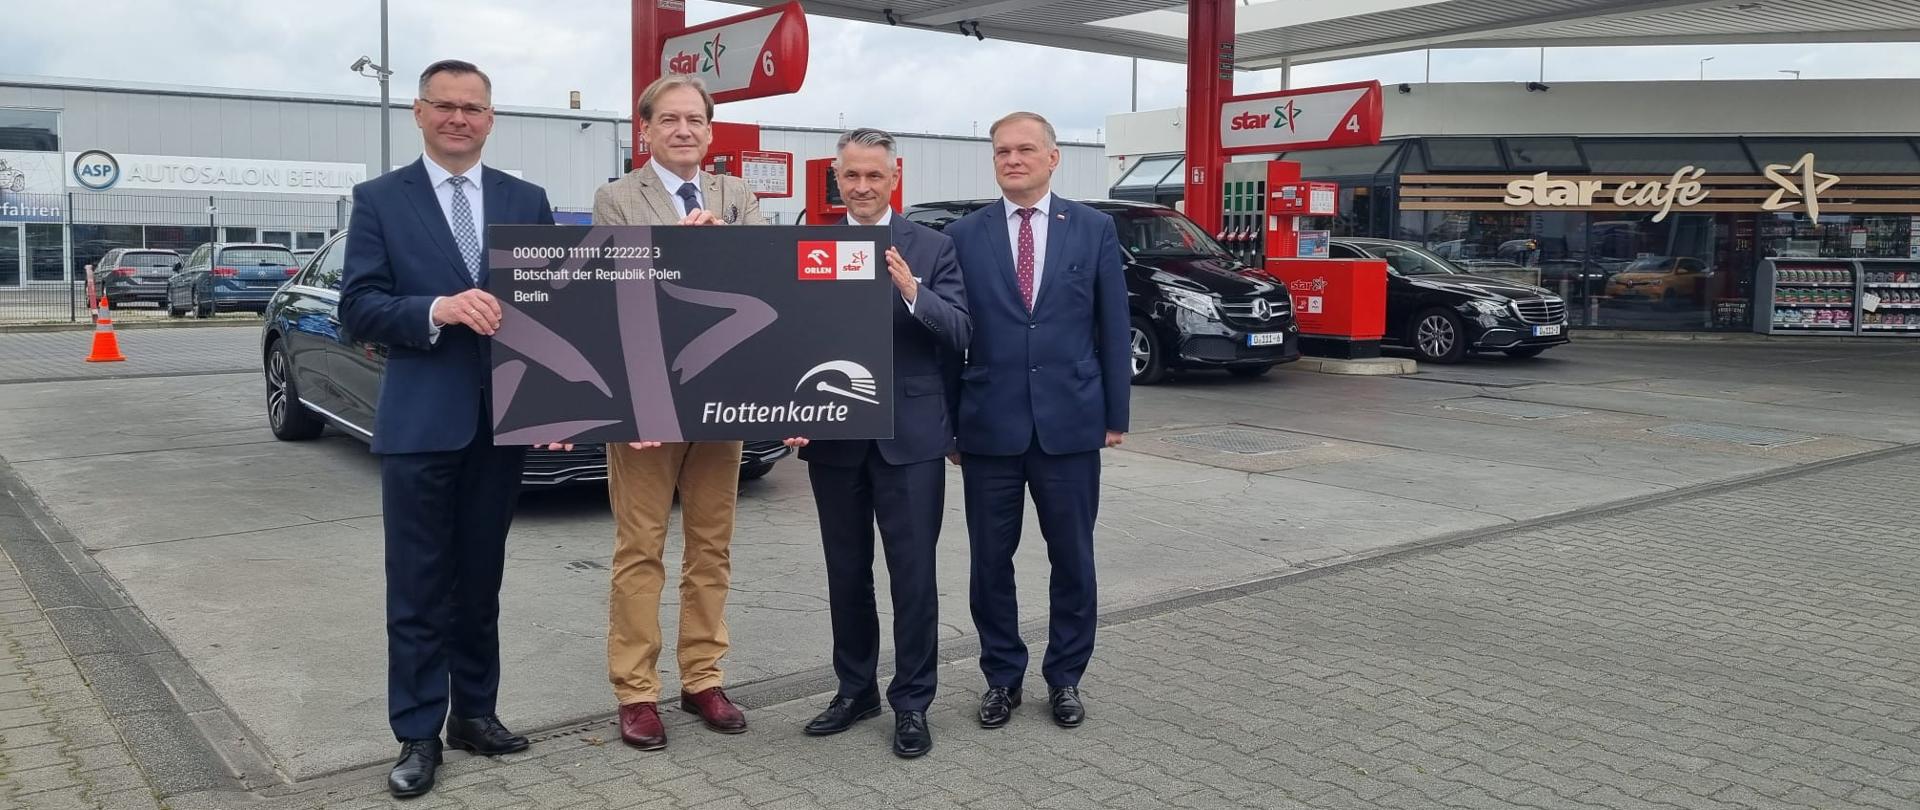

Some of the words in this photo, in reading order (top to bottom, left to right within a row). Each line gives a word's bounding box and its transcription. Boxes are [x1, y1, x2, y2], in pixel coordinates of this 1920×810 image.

[669, 50, 699, 75] star
[762, 50, 775, 77] 6
[1230, 111, 1270, 131] star
[1345, 114, 1360, 133] 4
[81, 164, 112, 177] ASP
[126, 164, 280, 187] AUTOSALON
[1503, 171, 1602, 207] star
[1613, 165, 1710, 223] café
[513, 247, 565, 259] 000000
[568, 247, 600, 259] 111111
[604, 247, 650, 259] 222222
[653, 247, 661, 258] 3
[513, 268, 569, 281] Botschaft
[572, 268, 592, 280] der
[595, 268, 645, 281] Republik
[648, 268, 681, 280] Polen
[804, 266, 832, 275] ORLEN
[842, 263, 862, 272] star
[1290, 280, 1313, 291] star
[514, 290, 549, 302] Berlin
[702, 400, 849, 424] Flottenkarte
